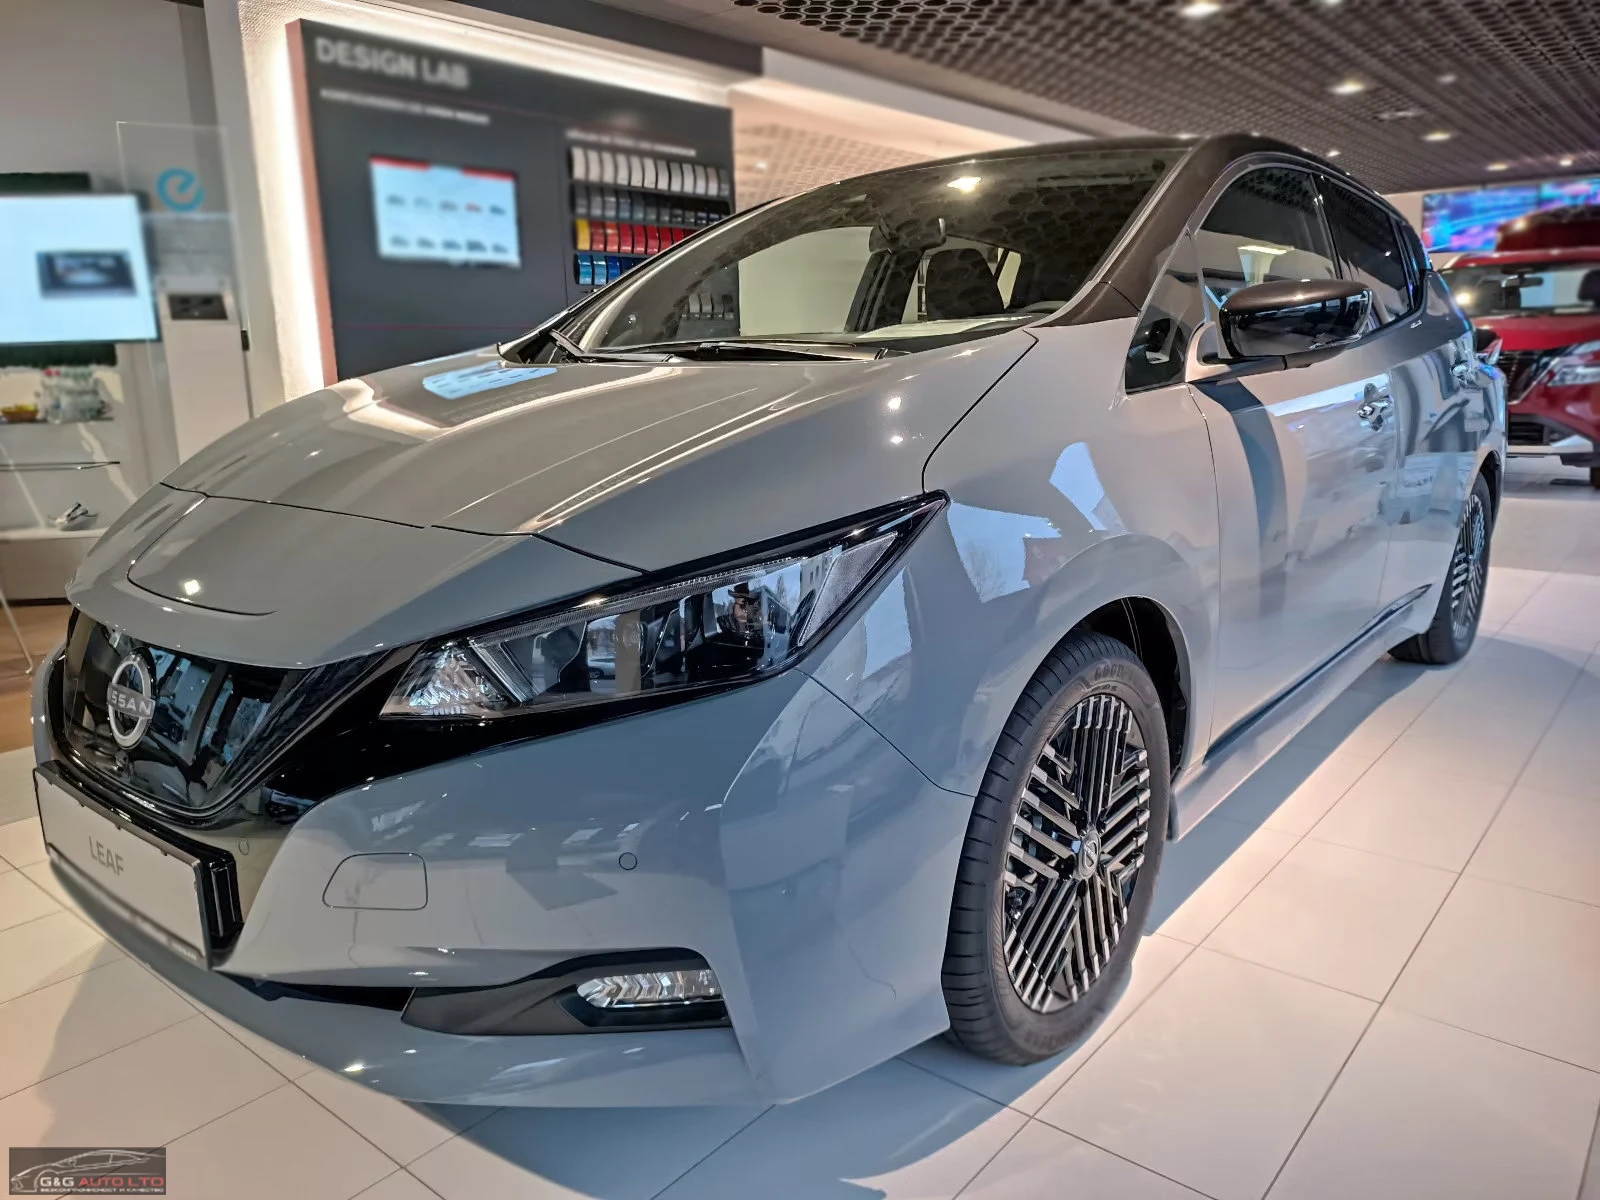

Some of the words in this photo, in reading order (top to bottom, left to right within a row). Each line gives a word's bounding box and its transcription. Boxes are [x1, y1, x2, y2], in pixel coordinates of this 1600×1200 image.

[315, 37, 417, 79] DESIGN
[421, 57, 470, 89] LAB
[110, 690, 152, 716] SSAN
[89, 836, 124, 876] LEAF
